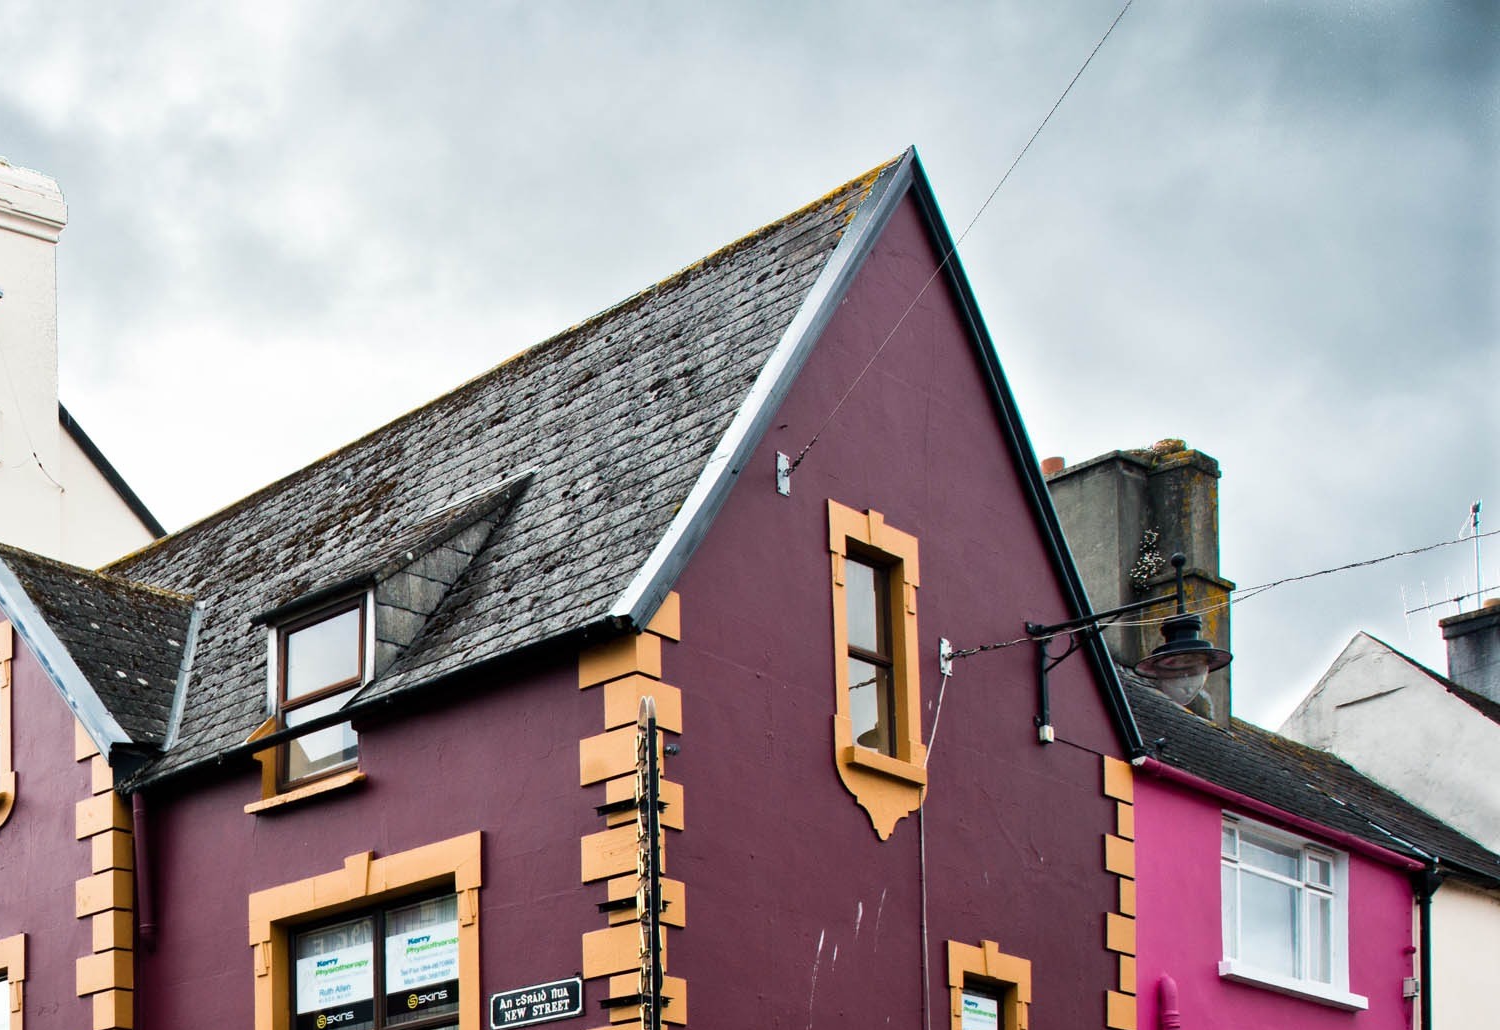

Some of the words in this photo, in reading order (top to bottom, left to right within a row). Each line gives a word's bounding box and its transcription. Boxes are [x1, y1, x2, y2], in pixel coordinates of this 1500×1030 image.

[408, 935, 431, 945] Kerry
[316, 958, 368, 976] Physiotherapy
[317, 957, 338, 967] Kerry
[504, 1008, 526, 1021] NEW
[532, 999, 570, 1016] STREET
